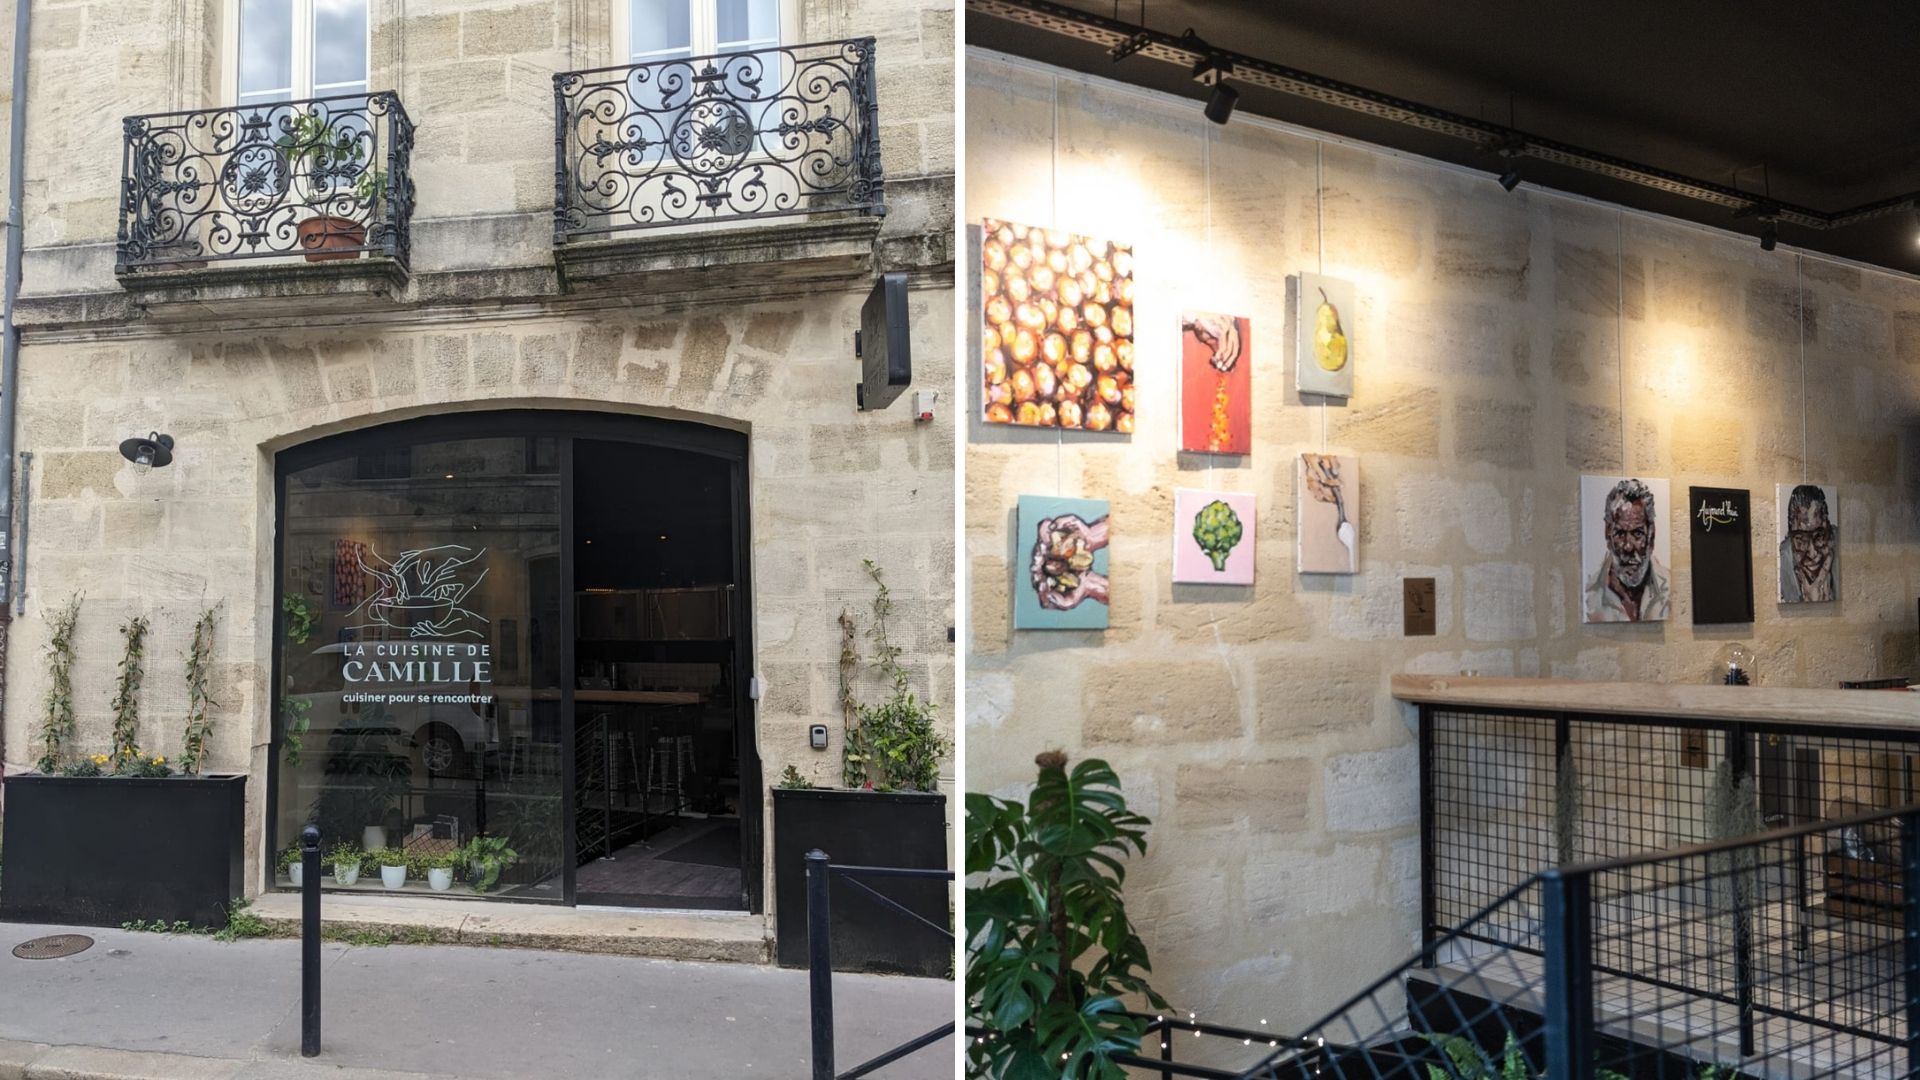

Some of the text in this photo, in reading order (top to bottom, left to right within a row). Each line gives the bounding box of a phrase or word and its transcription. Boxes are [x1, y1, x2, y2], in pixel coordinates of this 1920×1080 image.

[344, 645, 490, 656] LA CUISINE DE
[342, 660, 492, 683] CAMILLE
[343, 692, 493, 705] cuisiner pour se rencontrer
